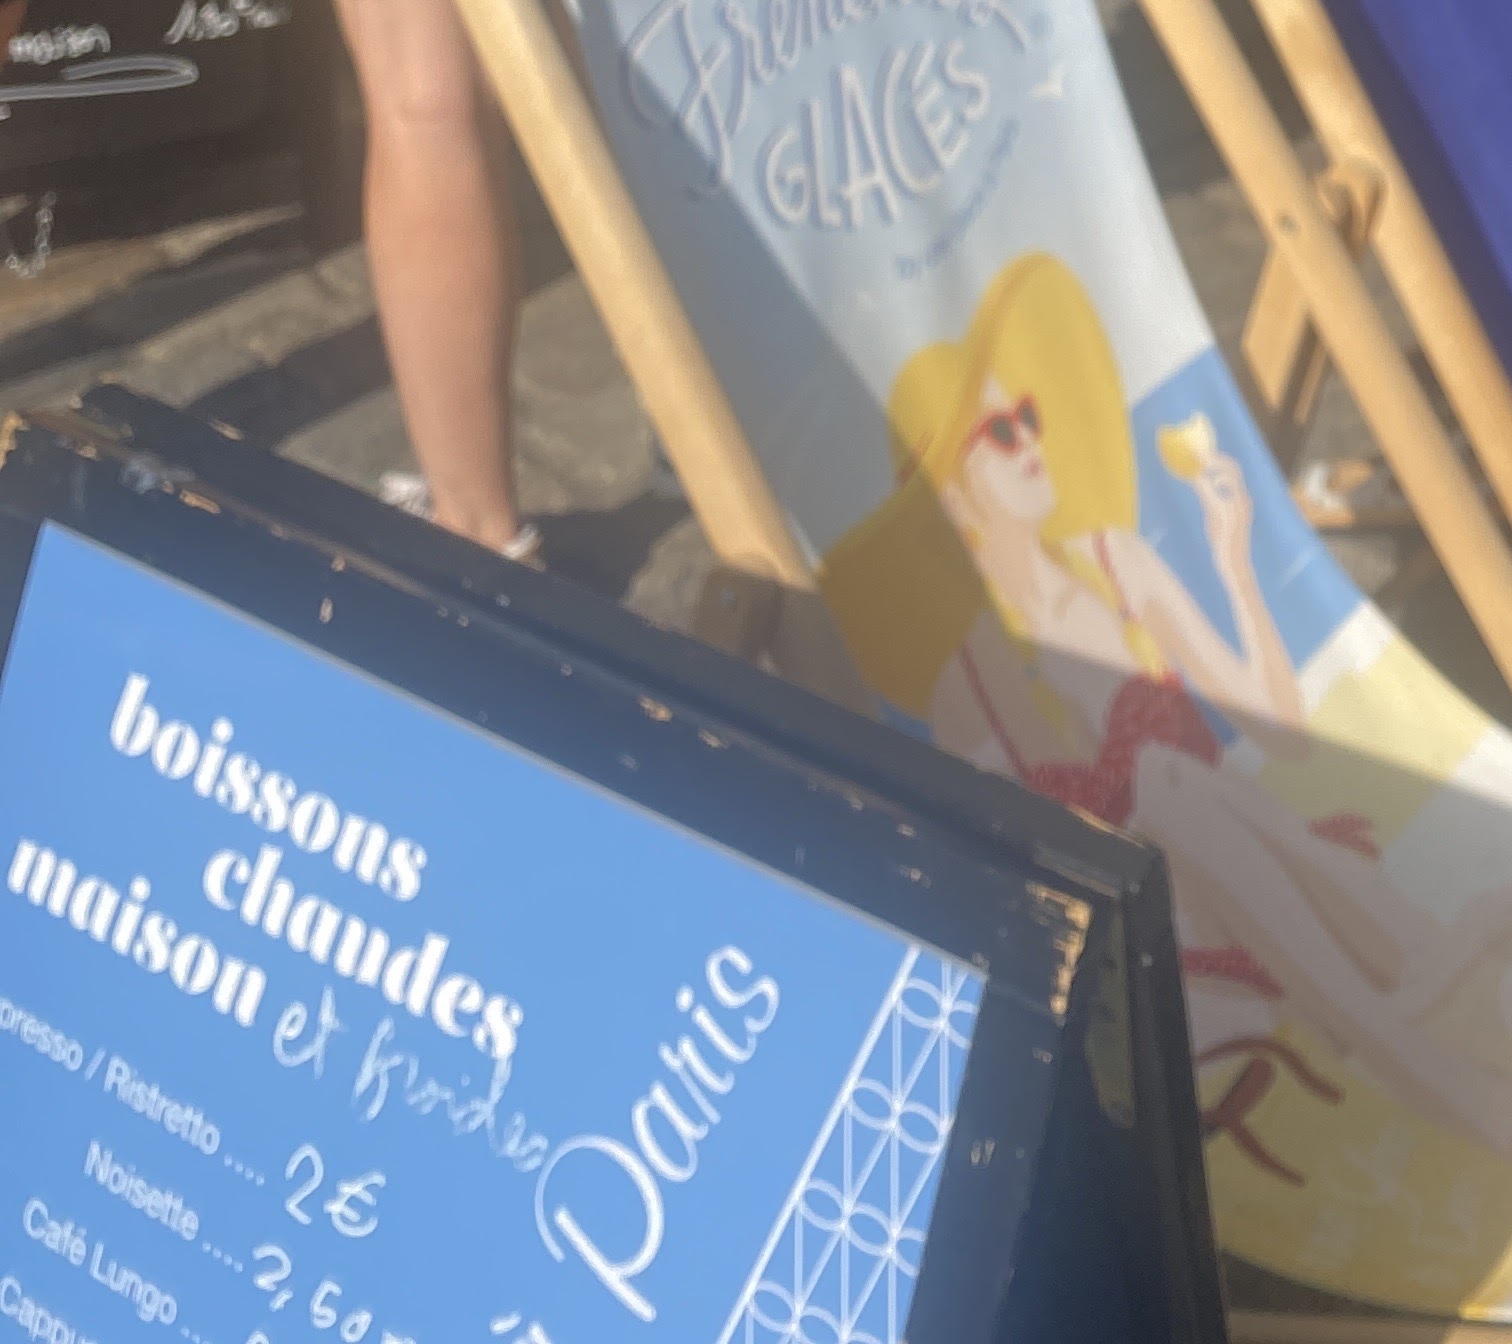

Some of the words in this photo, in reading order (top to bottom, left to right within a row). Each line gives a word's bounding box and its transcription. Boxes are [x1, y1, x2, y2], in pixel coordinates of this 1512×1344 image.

[758, 38, 990, 232] GLACES
[109, 671, 427, 902] boissons
[7, 839, 267, 1027] maison
[202, 844, 524, 1059] chaudes
[84, 1139, 200, 1241] Noisette
[104, 1054, 220, 1155] Ristretto
[535, 945, 779, 1324] Paris
[23, 1197, 87, 1267] Café
[90, 1240, 177, 1325] Lungo
